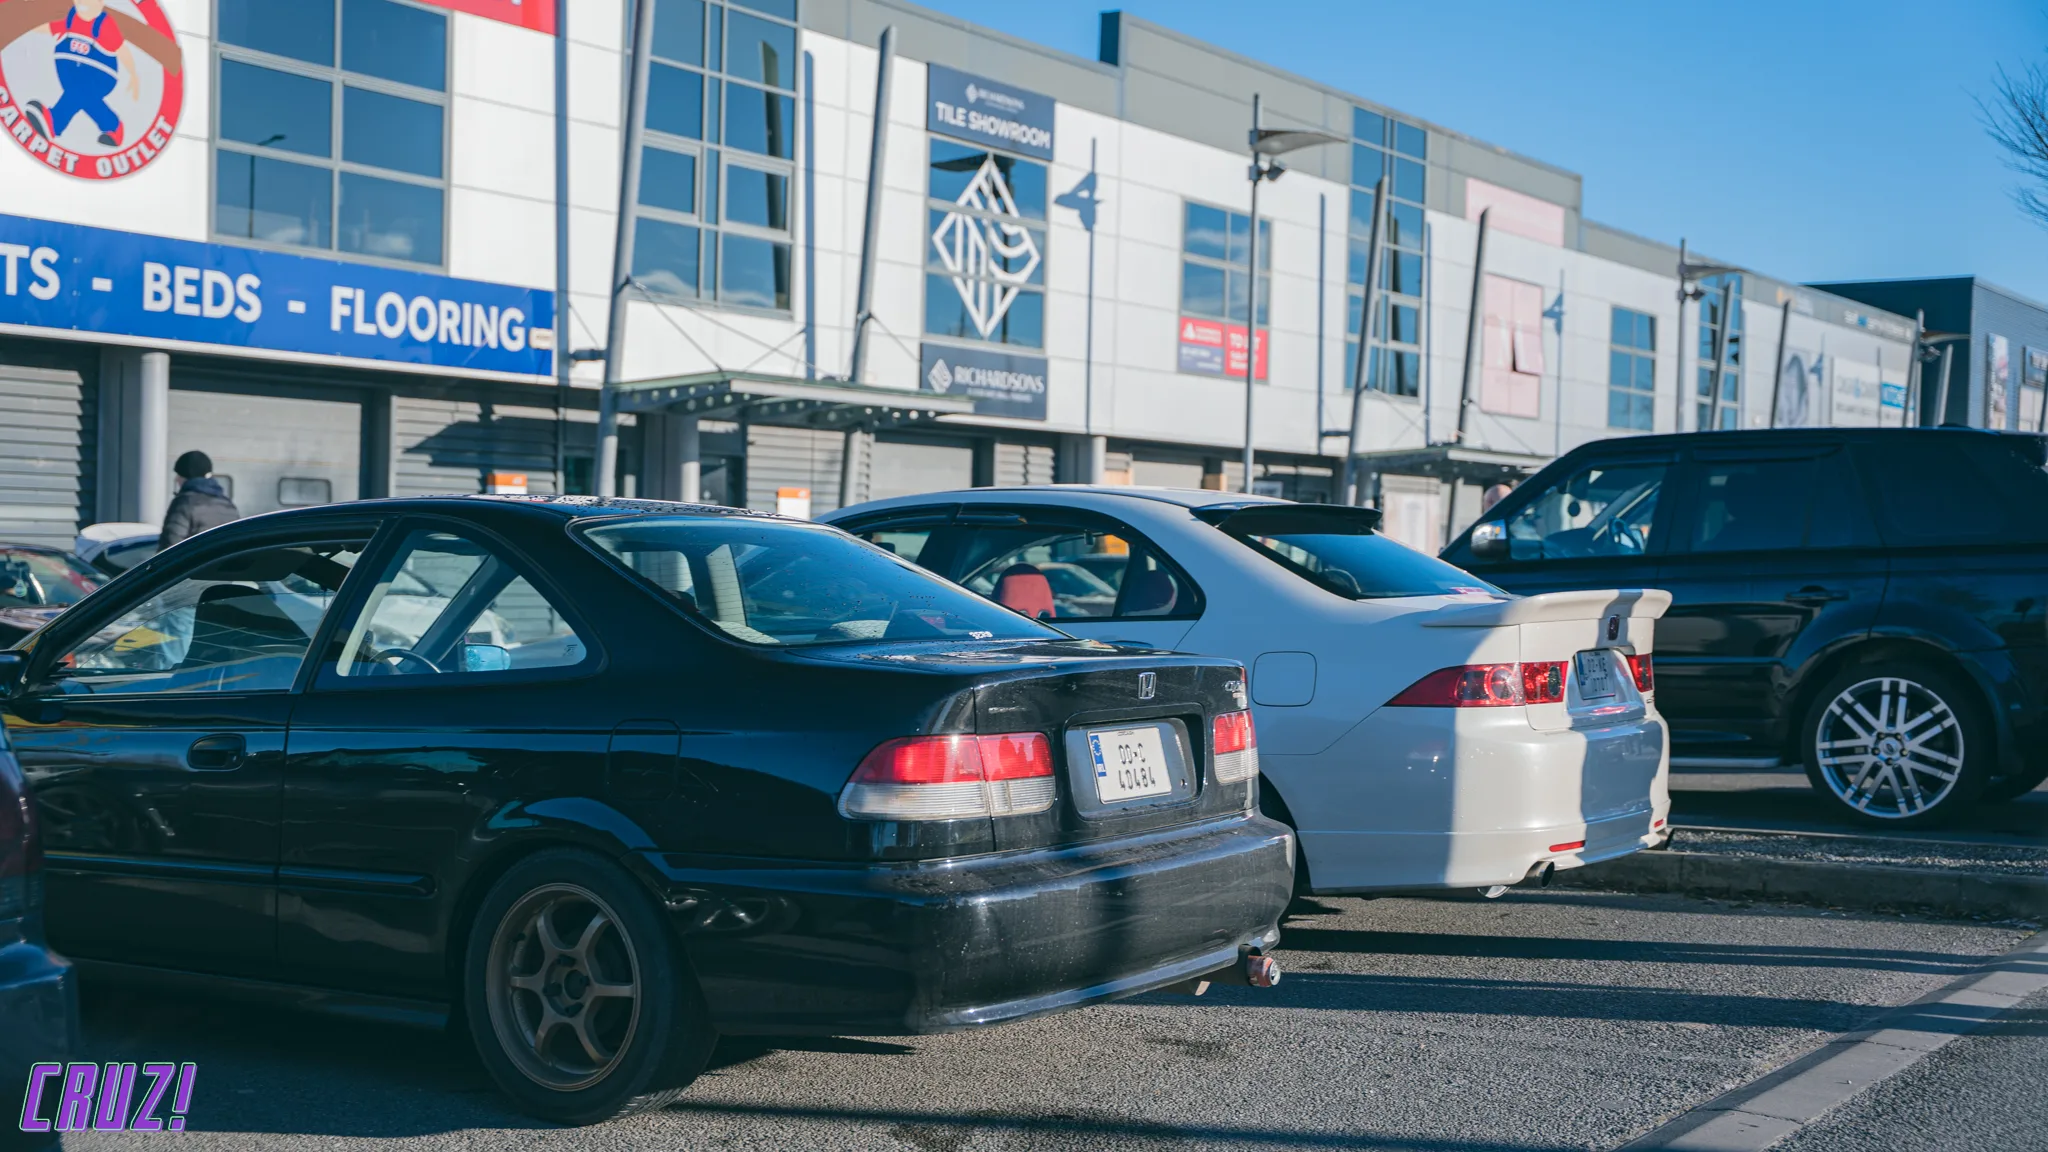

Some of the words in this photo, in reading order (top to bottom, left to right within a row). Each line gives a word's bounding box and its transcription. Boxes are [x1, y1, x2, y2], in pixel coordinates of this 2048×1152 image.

[96, 115, 174, 178] OUTLET
[935, 101, 967, 128] TILE
[968, 110, 1051, 149] SHOWROOM
[143, 261, 262, 324] BEDS
[330, 284, 526, 352] FLOORING
[954, 365, 1045, 394] RICHARDSONS
[1118, 766, 1157, 791] 40484
